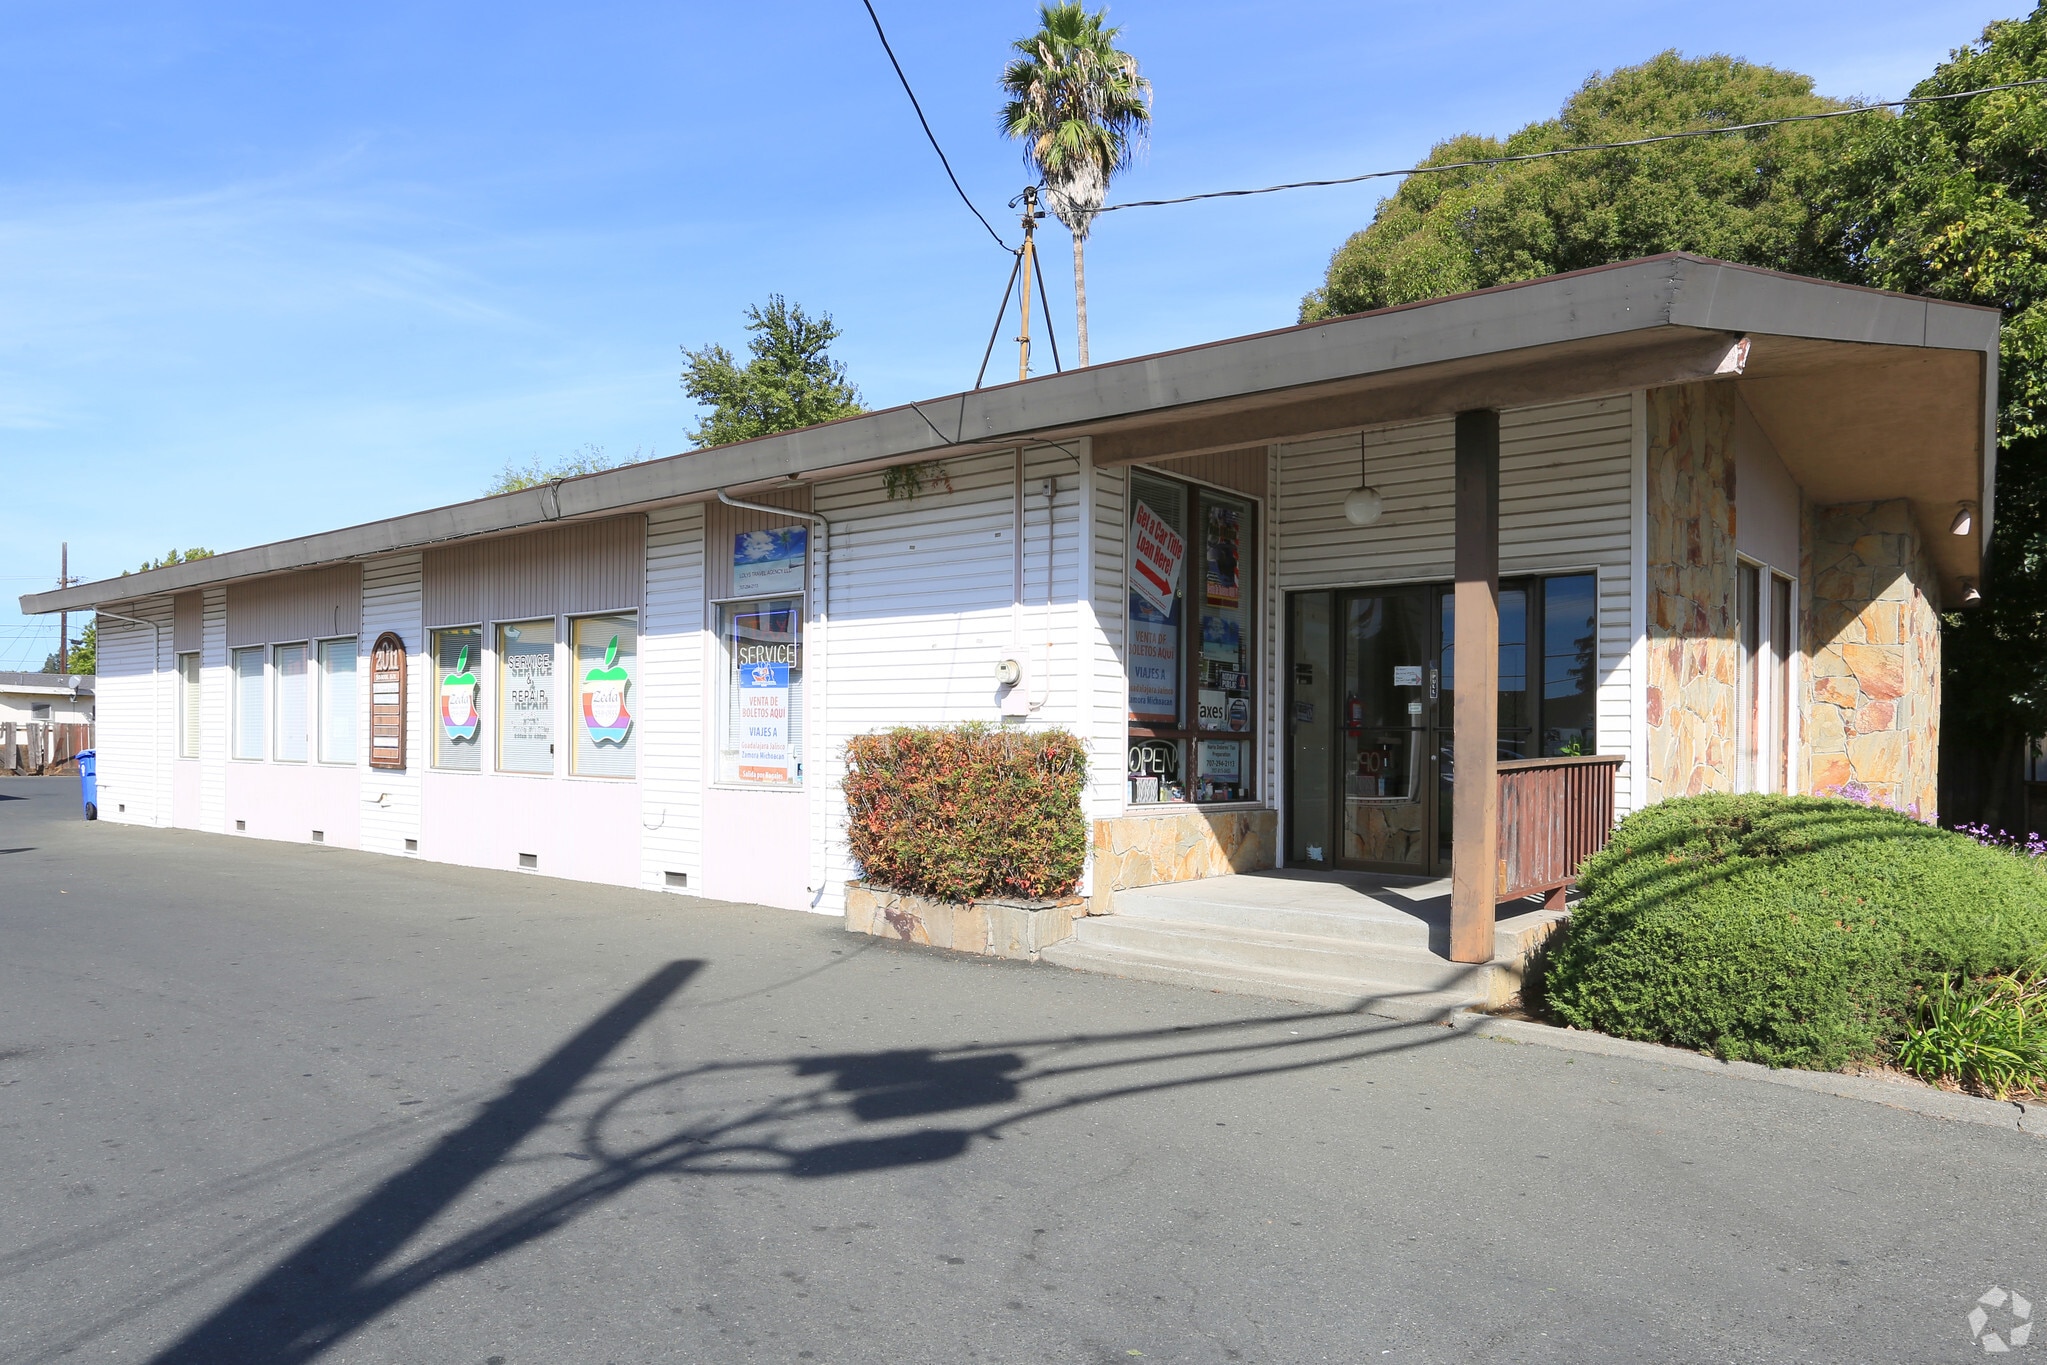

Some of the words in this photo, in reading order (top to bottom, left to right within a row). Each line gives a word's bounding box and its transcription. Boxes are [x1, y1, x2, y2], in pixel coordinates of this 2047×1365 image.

[1136, 505, 1151, 531] Get
[1148, 519, 1155, 536] a
[1154, 521, 1168, 546] Car
[1167, 532, 1183, 560] Title
[1136, 530, 1155, 561] Loan
[1153, 545, 1174, 576] Here!
[1135, 630, 1157, 644] VENTA
[376, 643, 399, 671] 2011
[509, 654, 549, 669] SERVICE
[740, 643, 795, 665] SERVICE
[526, 672, 532, 685] &
[1135, 666, 1160, 679] VIAJES
[1161, 669, 1166, 680] A
[512, 690, 545, 703] REPAIR
[593, 687, 618, 703] Zeda
[749, 696, 769, 706] VENTA
[770, 696, 778, 706] DE
[742, 707, 769, 718] BOLETOS
[1199, 703, 1223, 719] axes
[749, 726, 771, 737] VIAJES
[773, 727, 778, 737] A
[1128, 746, 1175, 773] OPEN
